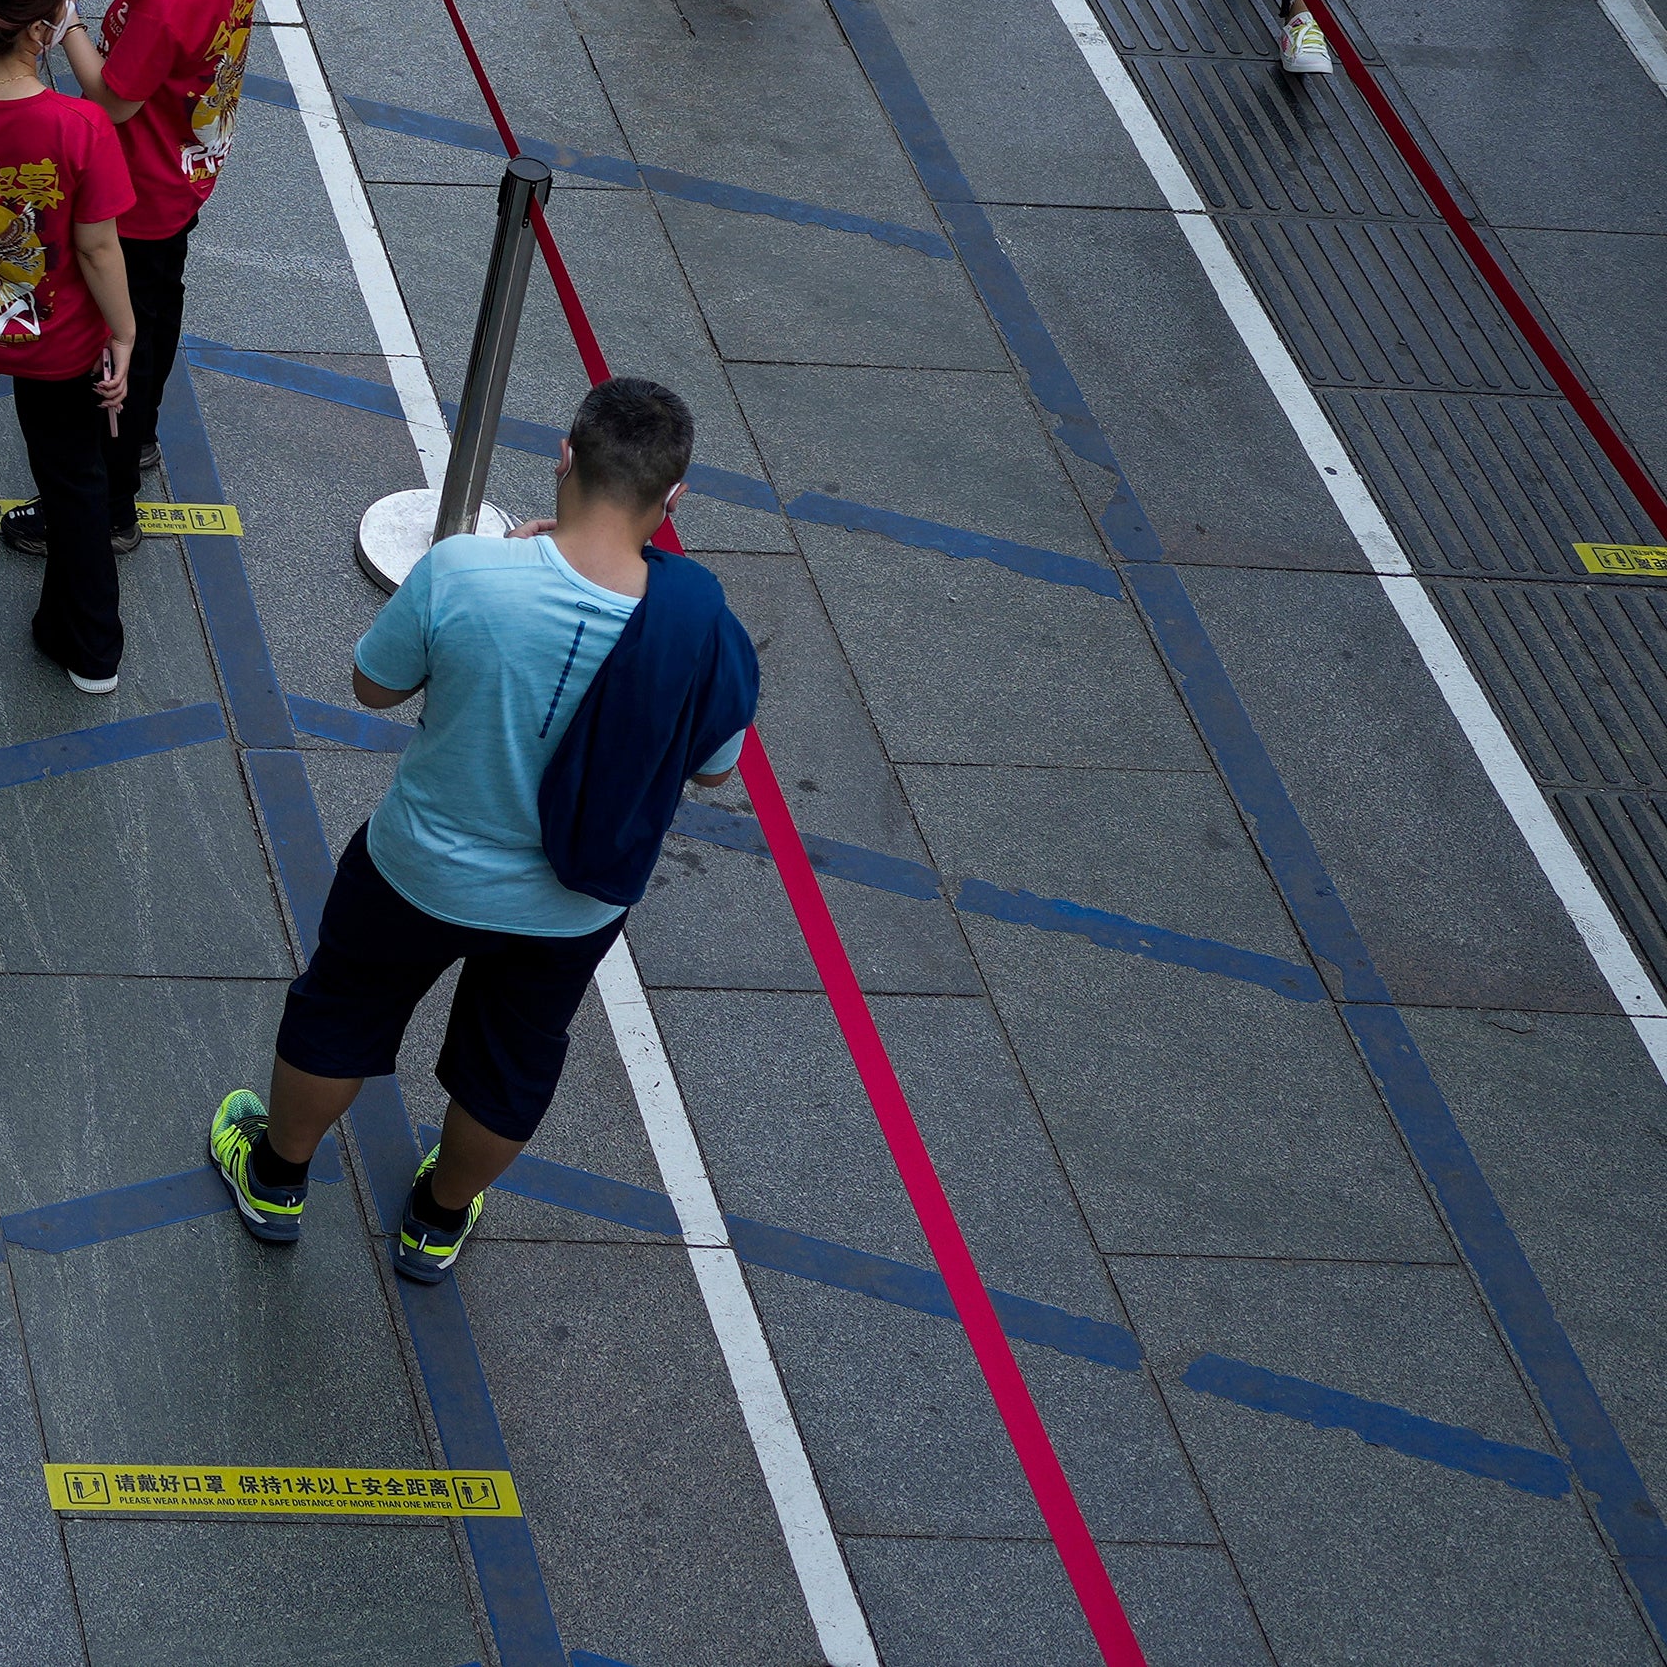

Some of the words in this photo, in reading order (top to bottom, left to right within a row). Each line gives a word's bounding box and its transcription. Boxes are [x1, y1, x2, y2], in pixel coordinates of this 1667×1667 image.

[114, 1473, 224, 1493] 请戴好口罩
[238, 1475, 449, 1497] 保持1米以上安全距离
[119, 1496, 154, 1504] PLEASE
[153, 1496, 178, 1504] WEAR
[189, 1497, 213, 1505] MASK
[217, 1497, 234, 1505] AND
[237, 1498, 257, 1506] KEEP
[260, 1498, 266, 1506] A
[269, 1498, 290, 1506] SAFE
[292, 1498, 334, 1506] DISTANCE
[350, 1499, 375, 1507] MORE
[403, 1500, 421, 1508] ONE
